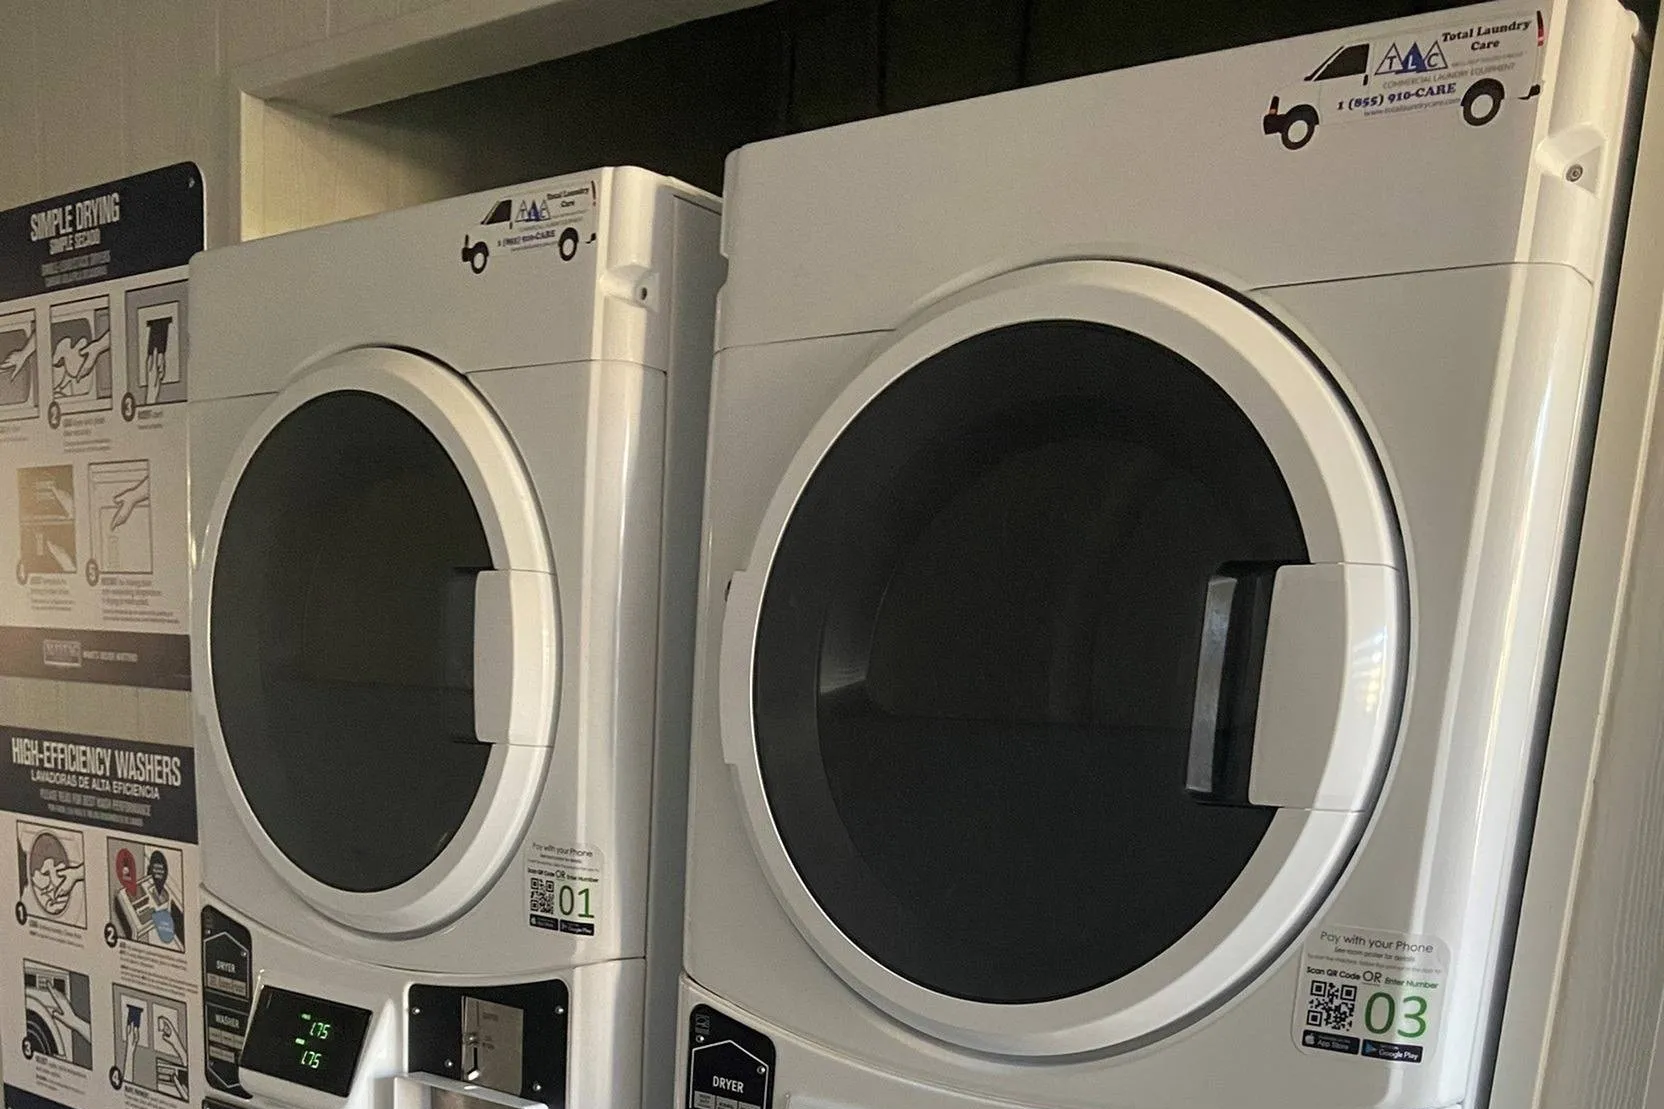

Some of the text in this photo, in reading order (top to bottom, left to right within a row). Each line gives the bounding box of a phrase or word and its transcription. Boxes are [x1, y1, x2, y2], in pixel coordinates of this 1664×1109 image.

[1442, 20, 1532, 43] Total Laundry
[1470, 38, 1500, 52] Care
[1382, 62, 1516, 90] COMMERCIAL LAUNDRY EQUIPMENT
[1336, 82, 1457, 111] 1 (855) 910-CARE
[30, 192, 120, 242] SIMPLE DRYING
[11, 736, 181, 787] HIGH-EFFICIENCY WASHERS
[30, 769, 160, 800] LAVADORAS DE ALTA EFICIENCIA
[555, 869, 566, 879] OR
[559, 885, 594, 918] 01
[107, 926, 115, 943] 2
[1320, 931, 1434, 954] Pay with your Phone
[216, 960, 236, 974] DRYER
[1306, 966, 1439, 990] Scan QR Code OR Enter Number
[215, 1013, 240, 1029] WASHER
[1364, 991, 1428, 1039] 03
[1316, 1039, 1331, 1048] App
[1379, 1049, 1419, 1061] Google Play
[711, 1075, 744, 1094] DRYER
